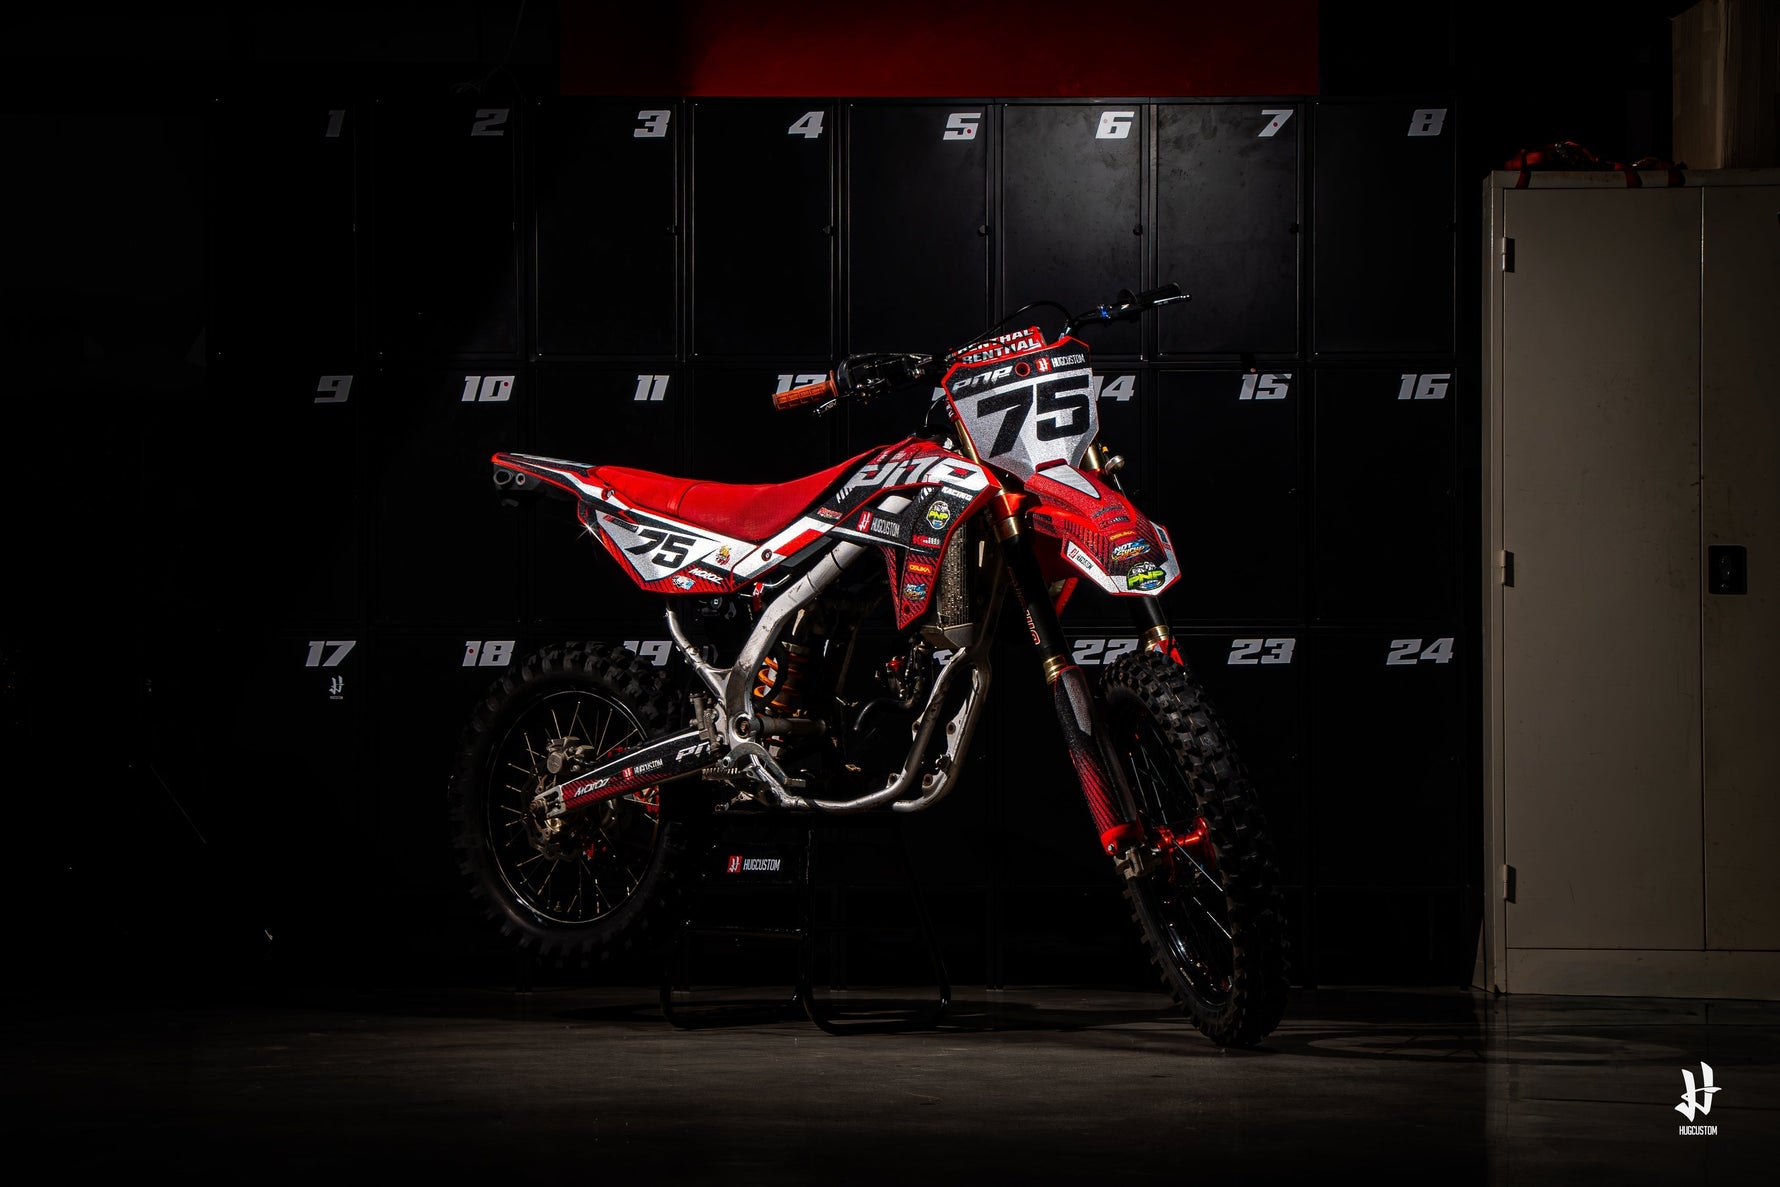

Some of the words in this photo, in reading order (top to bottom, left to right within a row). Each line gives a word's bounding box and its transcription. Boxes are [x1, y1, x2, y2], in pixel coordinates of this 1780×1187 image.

[325, 110, 345, 137] 1
[471, 109, 509, 136] 2
[634, 110, 671, 137] 3
[788, 111, 824, 138] 4
[943, 113, 981, 140] 5
[1095, 111, 1134, 139] 6
[1258, 110, 1293, 137] 7
[1408, 109, 1447, 136] 8
[1051, 354, 1085, 367] HUGCUSTOM
[314, 375, 353, 403] 9
[462, 376, 515, 401] 10
[634, 375, 669, 400] 11
[1239, 374, 1292, 400] 15
[1398, 374, 1451, 399] 16
[976, 374, 1090, 459] 75
[941, 486, 973, 501] RACING
[870, 517, 900, 537] HUGCUSTOM
[928, 510, 949, 520] PNP
[624, 528, 697, 568] 75
[1128, 570, 1164, 589] PNP
[305, 641, 356, 666] 17
[462, 641, 515, 666] 18
[1228, 639, 1295, 664] 23
[1387, 638, 1454, 665] 24
[743, 858, 780, 871] HUGCUSTOM
